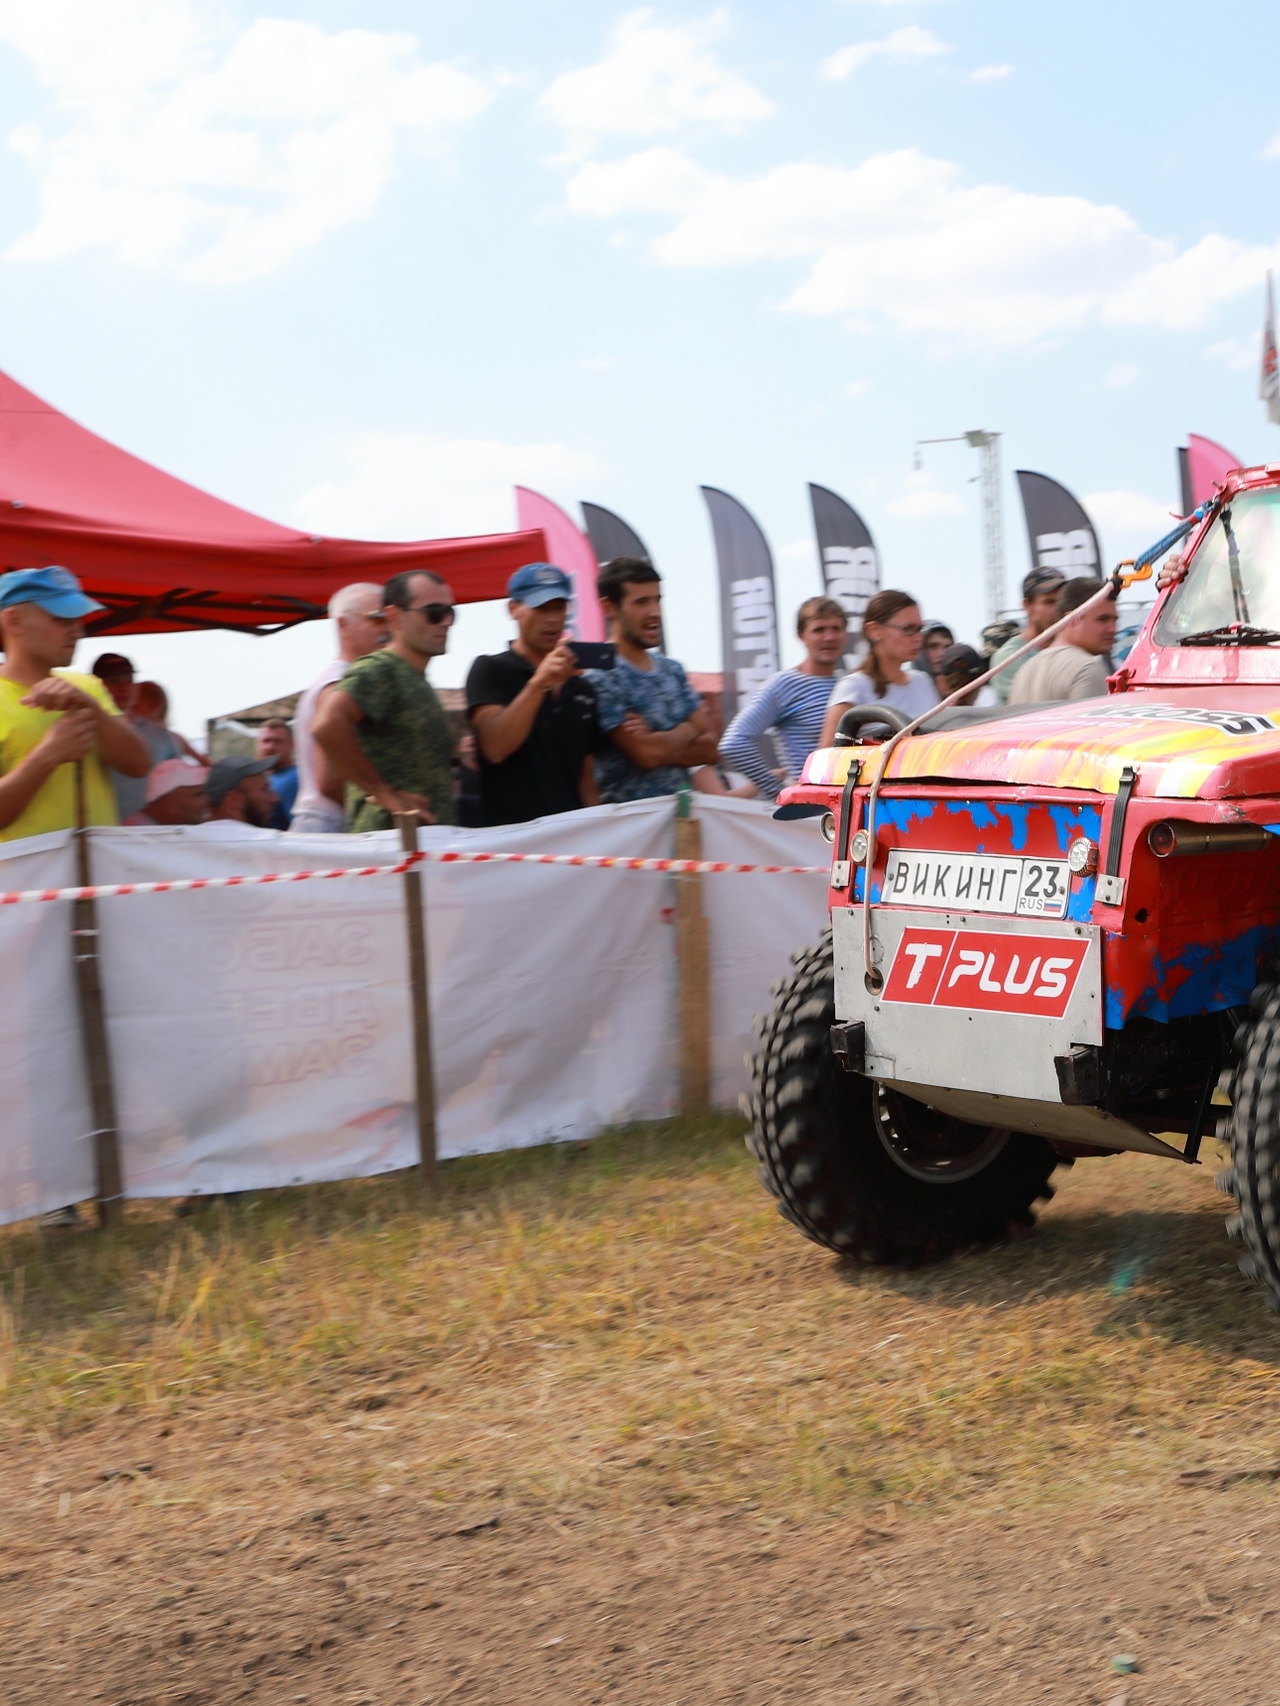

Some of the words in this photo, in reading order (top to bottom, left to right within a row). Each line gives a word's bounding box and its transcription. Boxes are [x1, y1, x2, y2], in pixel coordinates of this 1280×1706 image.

[893, 861, 1018, 902] ВИКИНГ
[1024, 865, 1059, 897] 23
[1019, 897, 1043, 910] RUS
[905, 942, 943, 990] T
[948, 950, 1075, 998] PLUS
